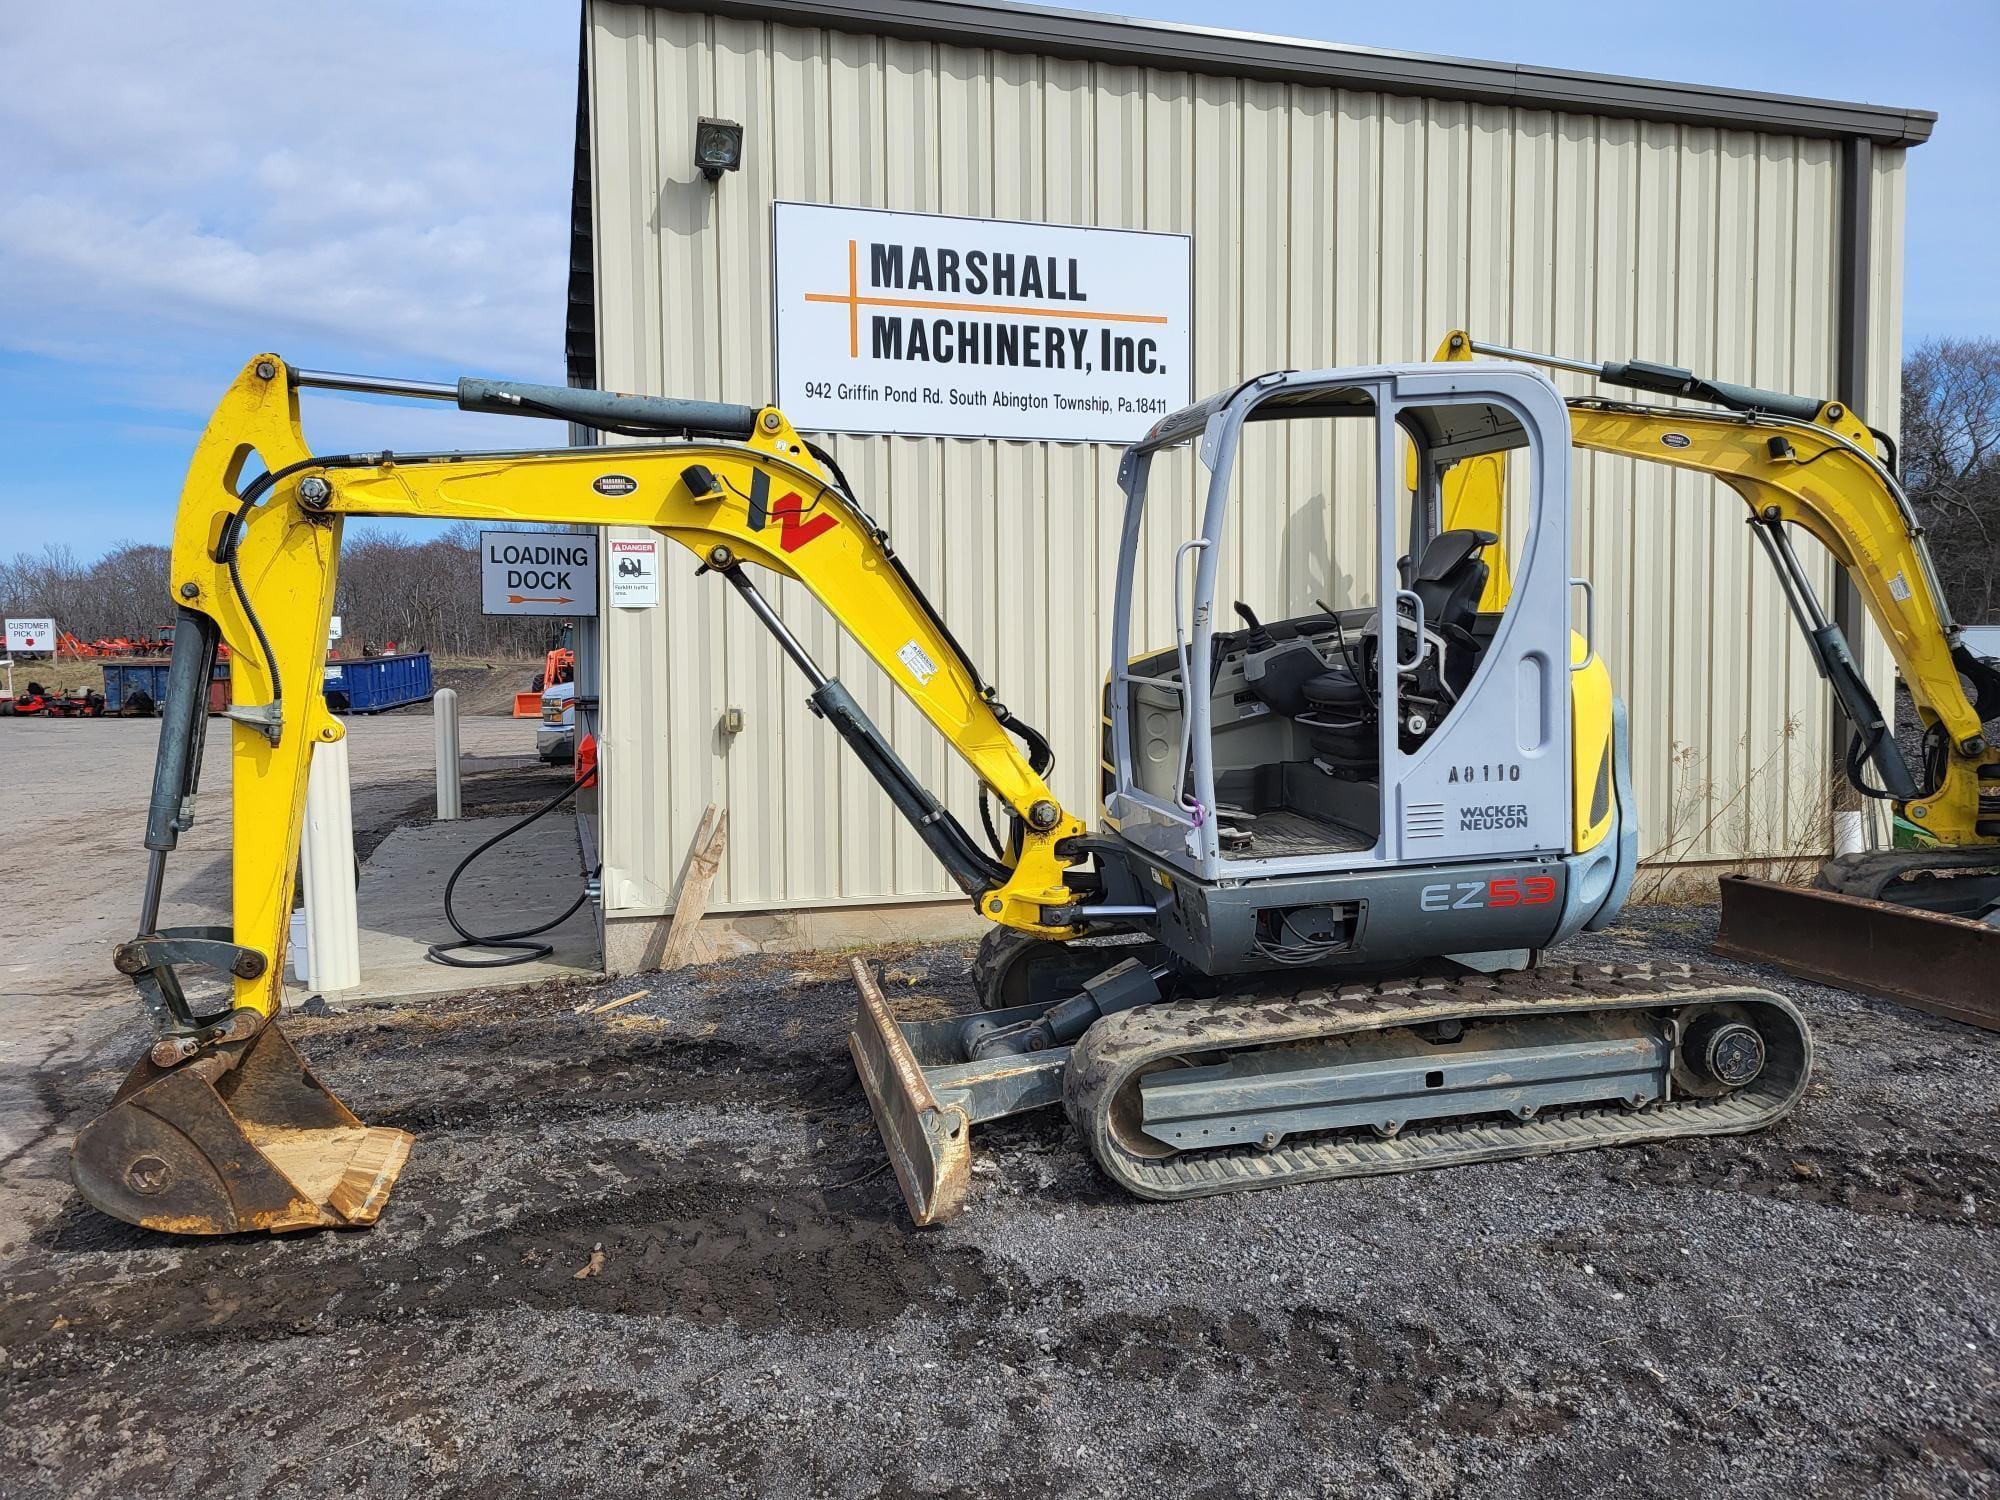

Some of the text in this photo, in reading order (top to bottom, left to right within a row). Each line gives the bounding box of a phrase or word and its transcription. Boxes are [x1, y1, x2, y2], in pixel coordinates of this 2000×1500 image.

[870, 243, 1087, 302] MARSHALL
[872, 315, 1167, 376] MACHINERY, Inc.
[805, 382, 1167, 415] 942 Griffin Pond Rd. South Abington Township, Pa.18411
[490, 545, 588, 567] LOADING
[507, 570, 572, 591] DOCK
[1460, 804, 1528, 819] WACKER
[1460, 814, 1529, 831] NEUSON
[1420, 876, 1556, 912] EZ53
